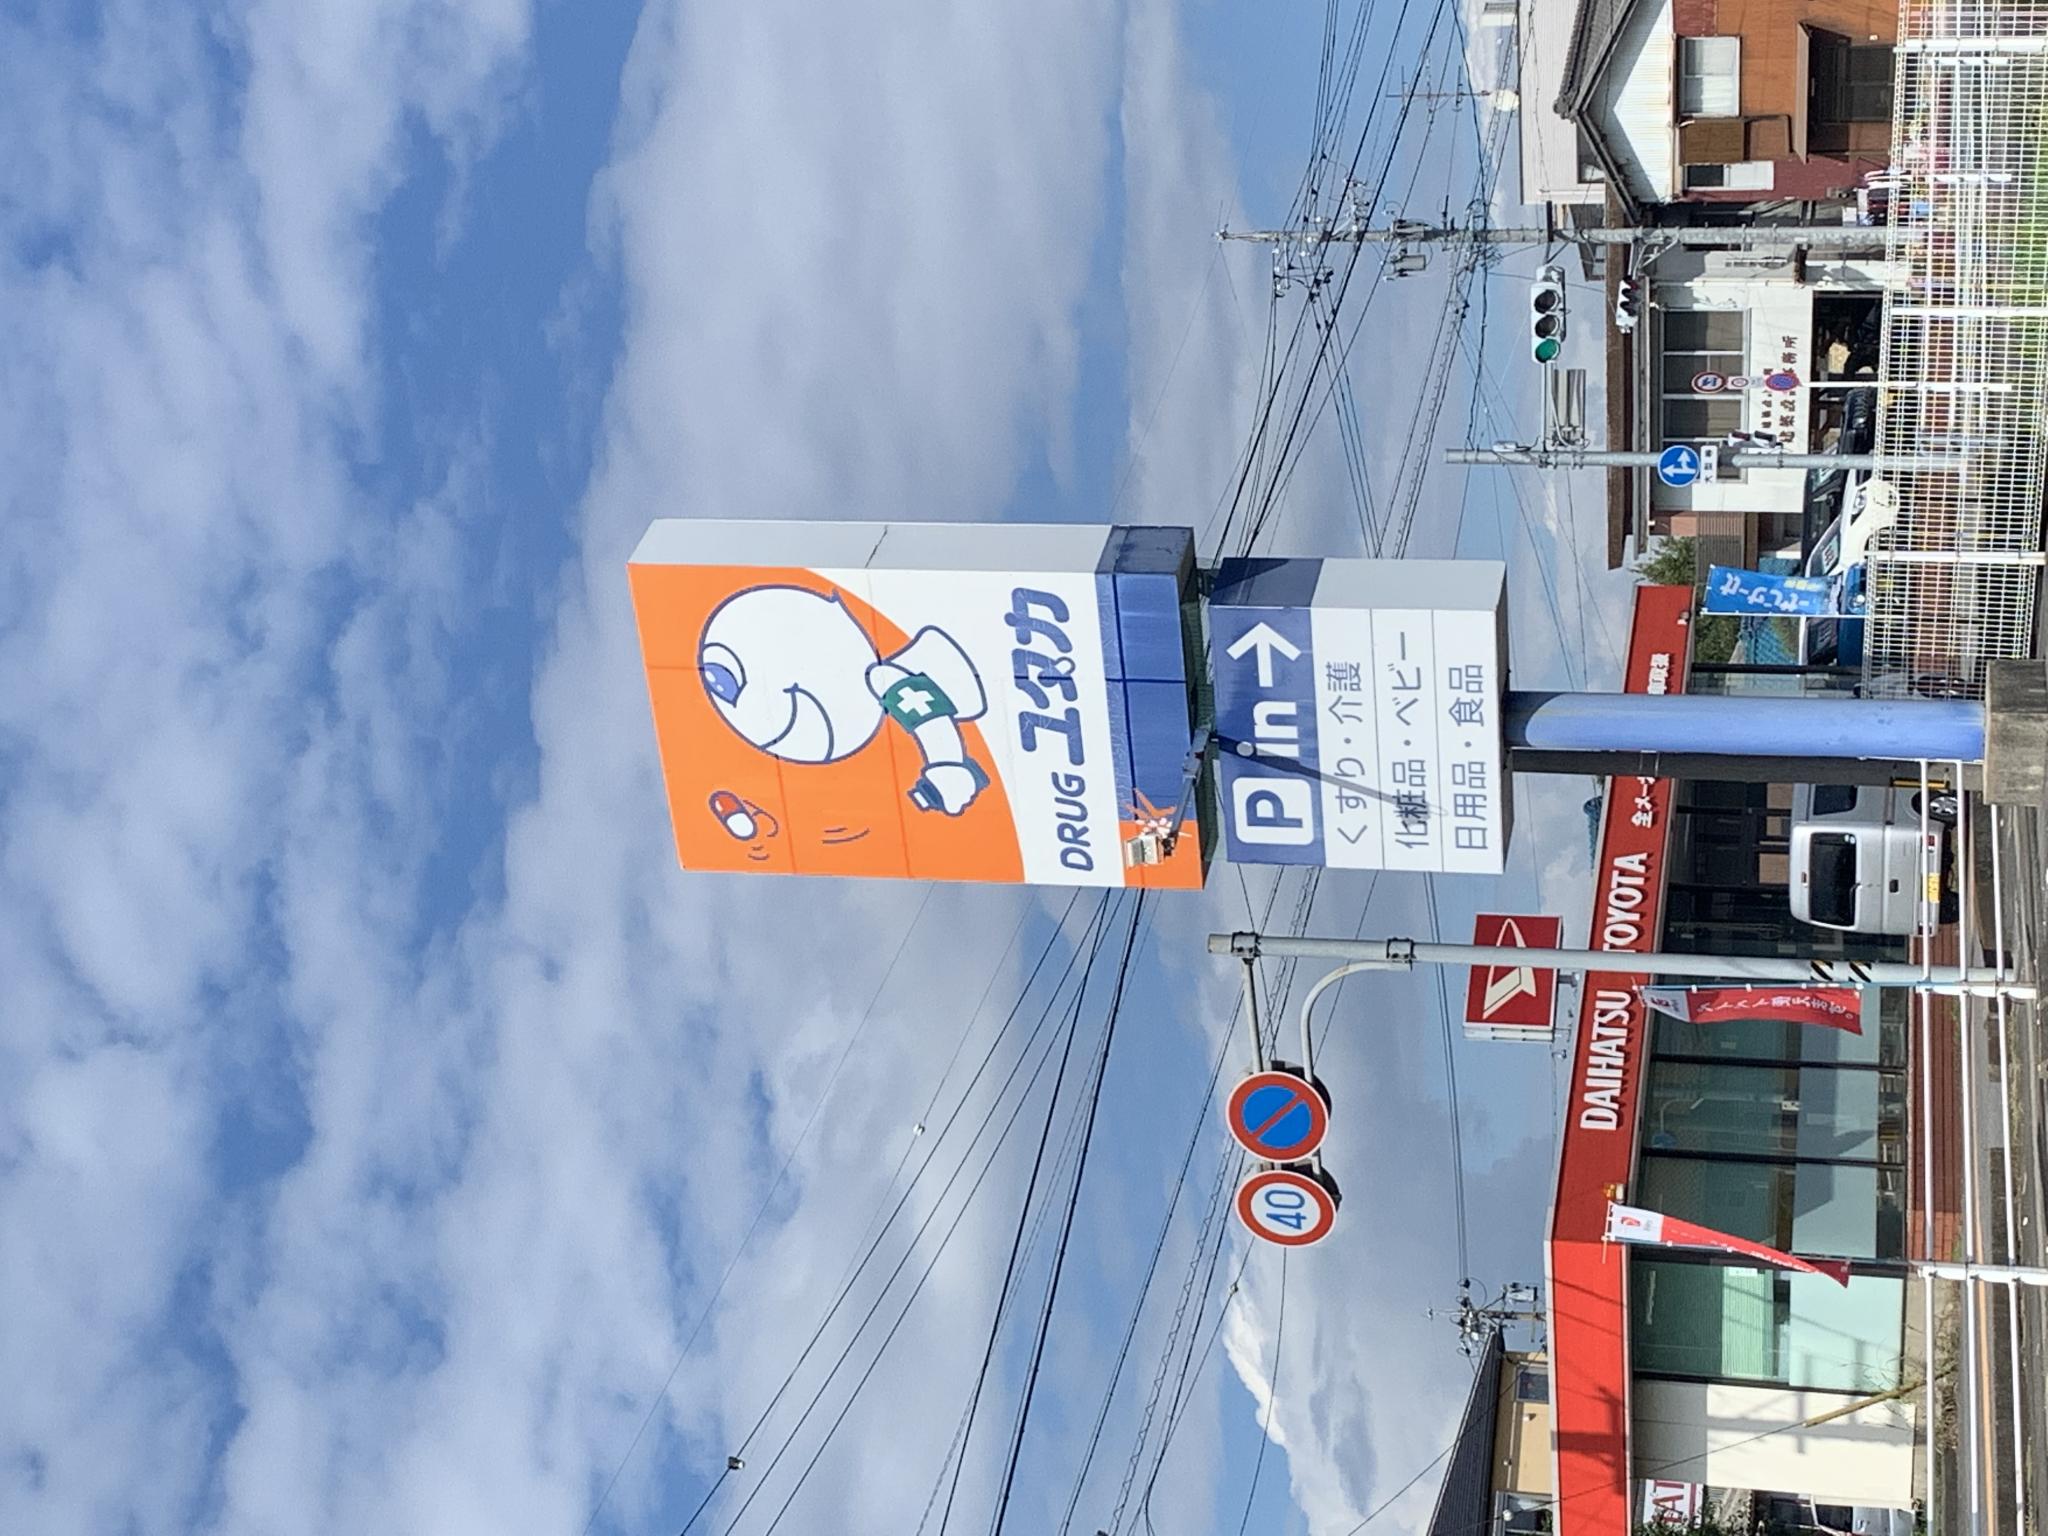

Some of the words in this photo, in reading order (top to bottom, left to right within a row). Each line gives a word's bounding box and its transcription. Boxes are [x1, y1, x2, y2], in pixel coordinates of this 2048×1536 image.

[1004, 587, 1085, 766] ユタカ
[1236, 700, 1300, 758] in
[1388, 631, 1430, 849] 化粧品・ベビー
[1051, 771, 1095, 872] DRUG
[1242, 786, 1306, 832] P
[1326, 661, 1368, 845] くすり・介護
[1448, 663, 1489, 850] 日用品・食品
[1580, 990, 1631, 1131] DAIHATSU
[1264, 1190, 1307, 1230] 40
